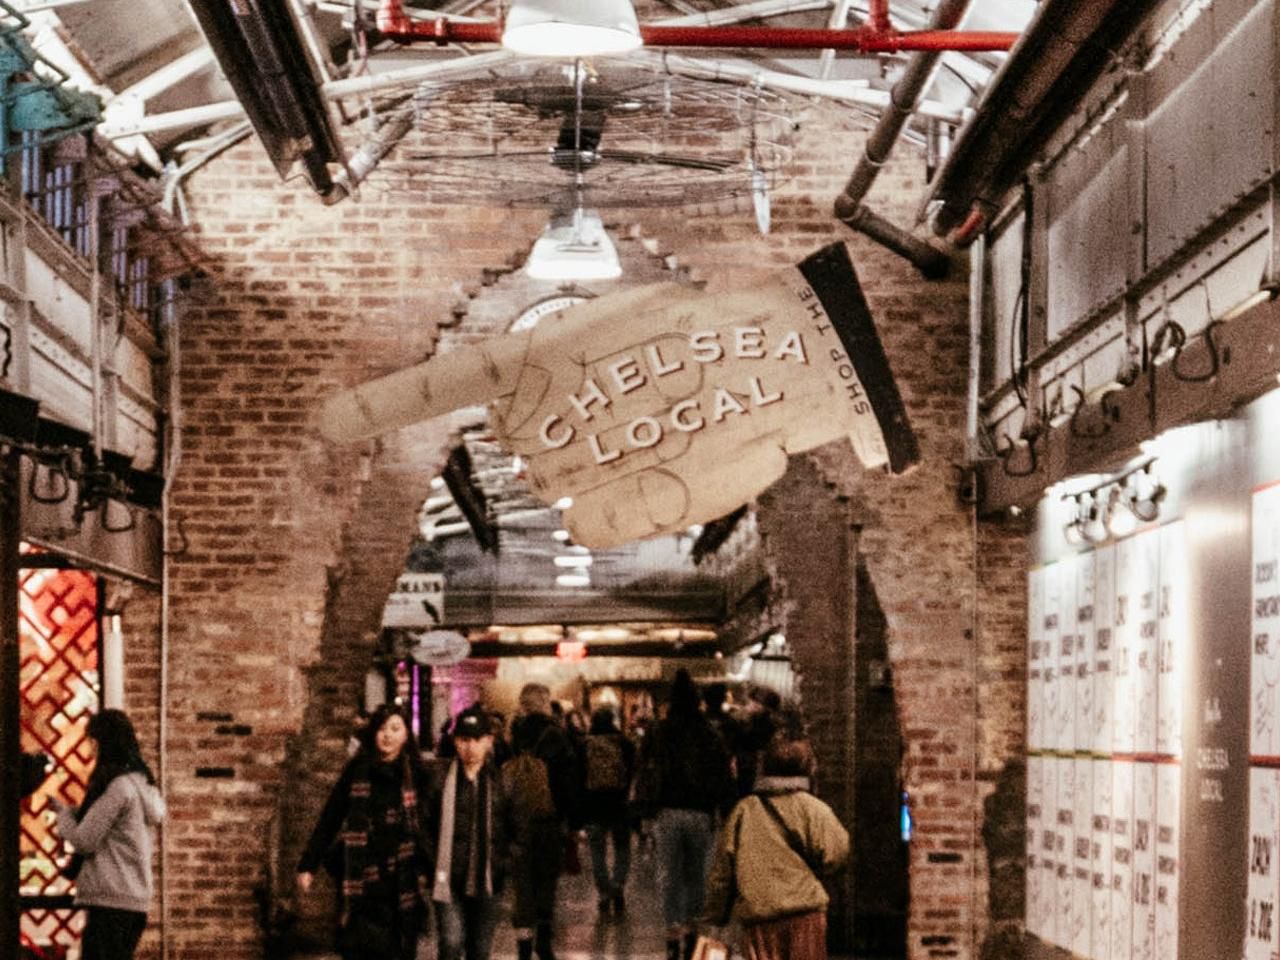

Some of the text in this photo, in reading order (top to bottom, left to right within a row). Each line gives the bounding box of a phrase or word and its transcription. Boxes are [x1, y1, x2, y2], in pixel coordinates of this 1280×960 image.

[538, 326, 810, 452] CHELSEA
[798, 286, 870, 416] SHOP THE
[589, 376, 786, 466] LOCAL
